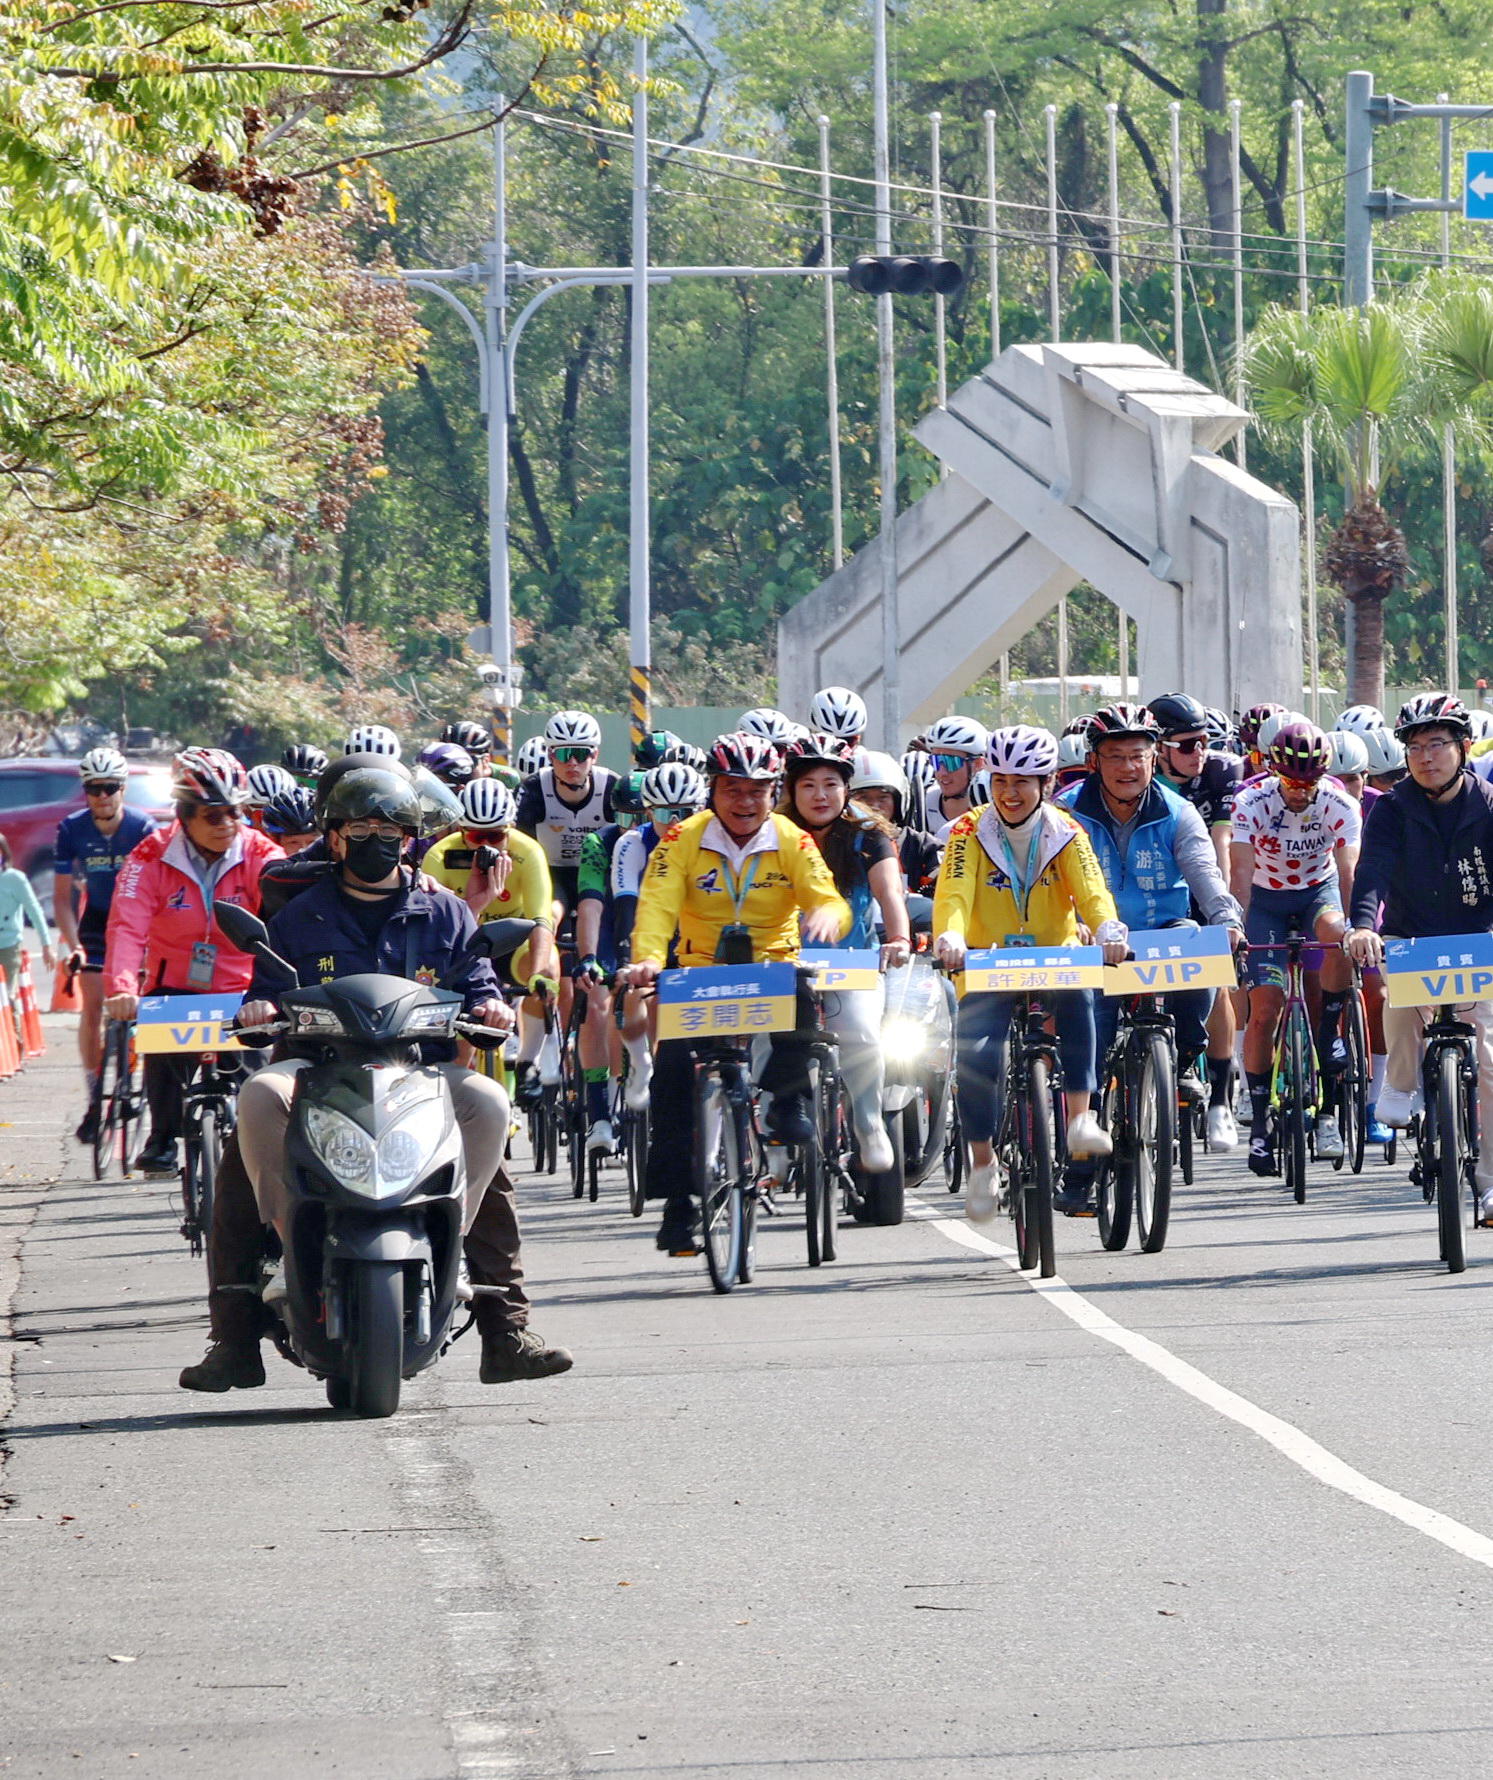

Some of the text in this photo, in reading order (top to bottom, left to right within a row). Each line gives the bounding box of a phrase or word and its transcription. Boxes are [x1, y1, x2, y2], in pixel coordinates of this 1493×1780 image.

[952, 838, 967, 879] TAIWAN
[1147, 946, 1182, 959] 貴賓
[1437, 953, 1474, 968] 貴賓
[987, 971, 1082, 988] 許淑華
[1131, 962, 1203, 986] VIP
[1420, 972, 1493, 998] VIP
[679, 1002, 775, 1031] 李開志
